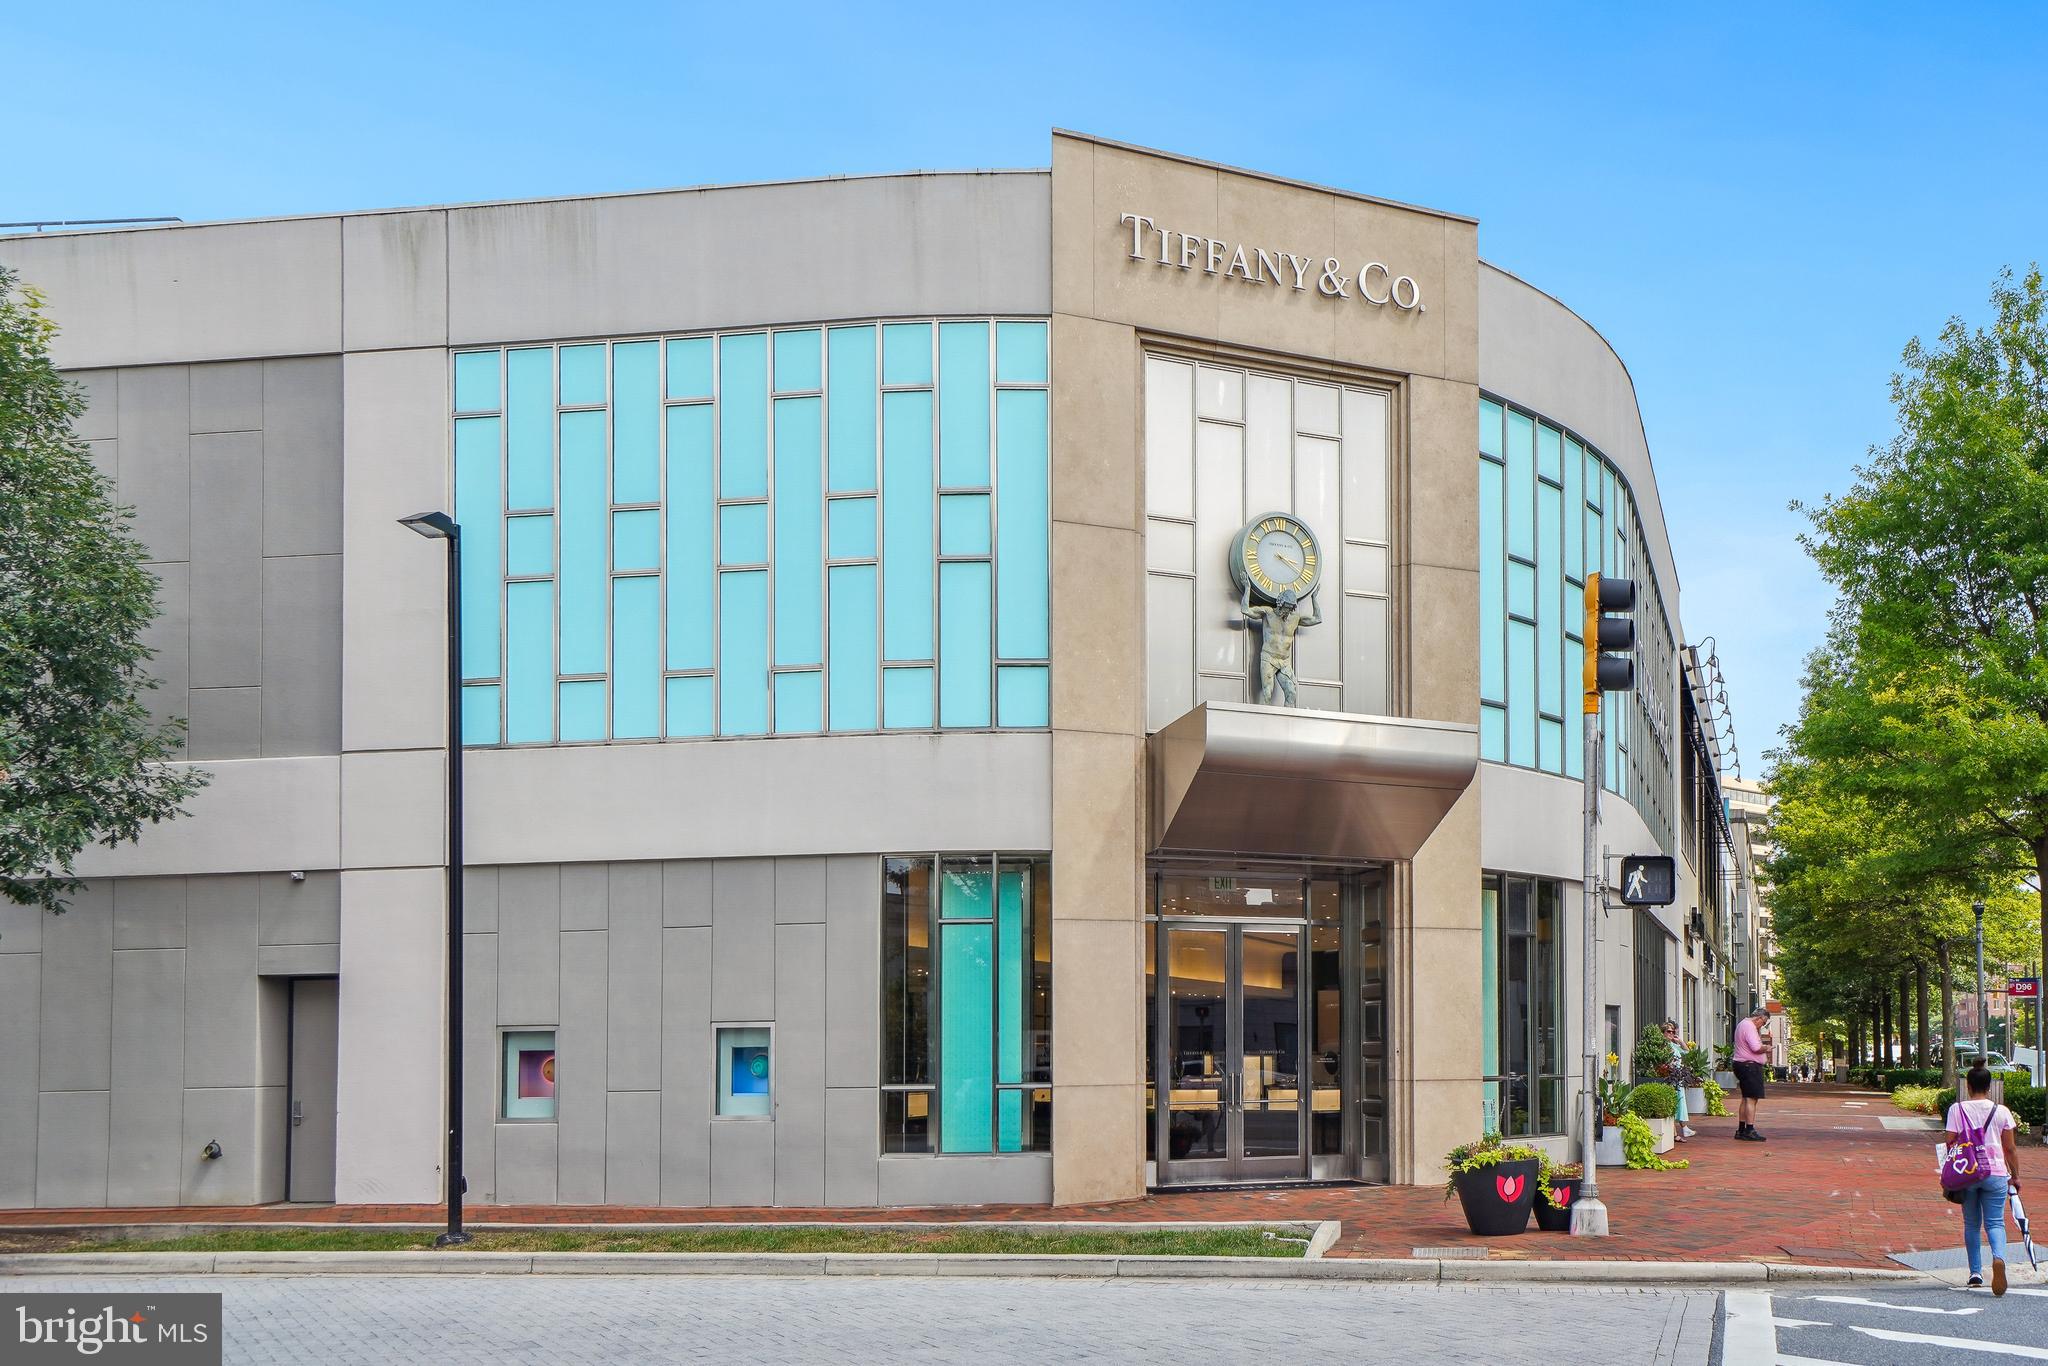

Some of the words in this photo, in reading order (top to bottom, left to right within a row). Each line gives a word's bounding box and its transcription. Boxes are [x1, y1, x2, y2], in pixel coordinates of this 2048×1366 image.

[1120, 212, 1312, 290] TIFFANY
[1318, 257, 1350, 298] &
[1358, 262, 1426, 312] CO.
[1260, 521, 1272, 534] XI
[1274, 519, 1286, 531] XII
[1293, 526, 1299, 536] I
[1250, 532, 1261, 544] X
[1301, 539, 1312, 548] II
[1247, 549, 1257, 560] IX
[1305, 555, 1316, 565] III
[1293, 581, 1301, 593] V
[2015, 983, 2032, 991] D96
